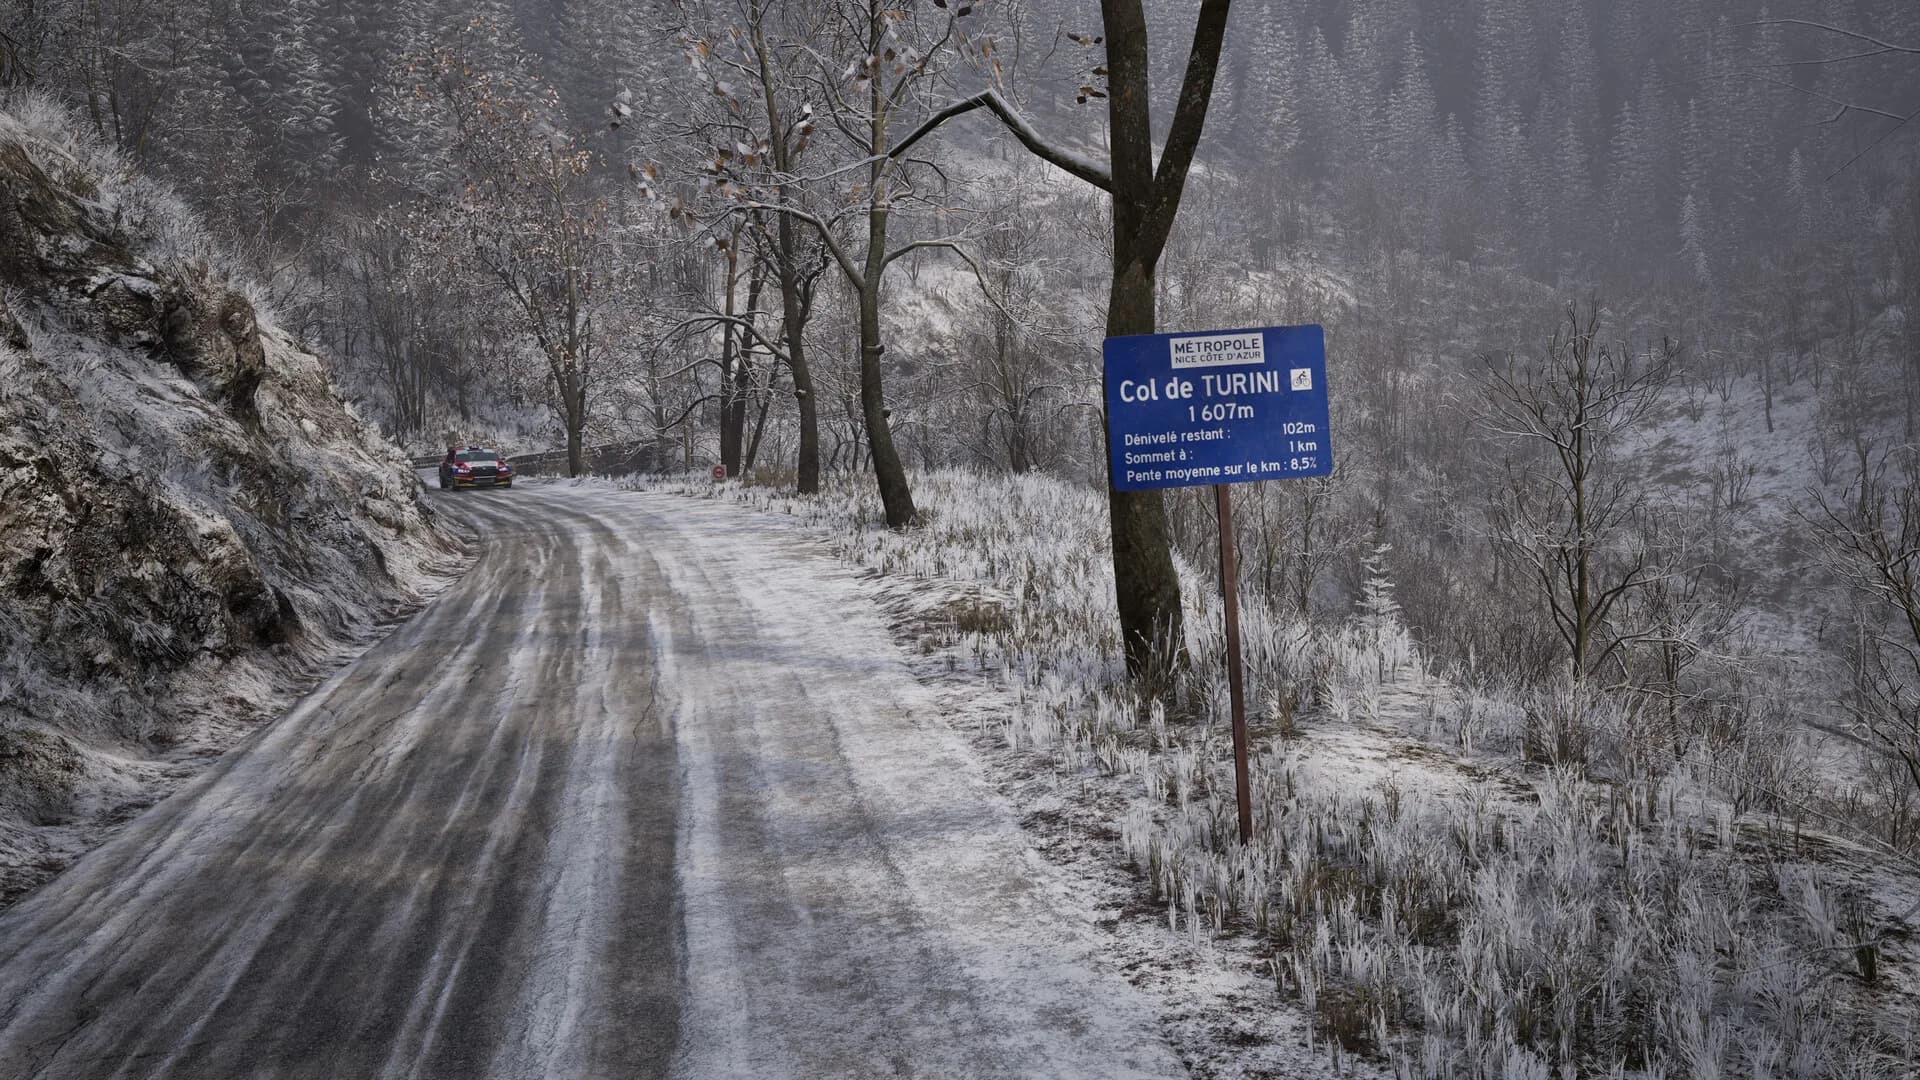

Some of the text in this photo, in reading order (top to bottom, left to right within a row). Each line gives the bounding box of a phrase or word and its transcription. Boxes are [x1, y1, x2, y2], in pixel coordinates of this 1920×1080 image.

[1174, 338, 1260, 354] MÉTROPOLE
[1175, 351, 1261, 364] NICE CÔTE D'AZUR
[1120, 370, 1279, 403] Col de TURINI
[1125, 431, 1177, 446] Dénivelé
[1181, 428, 1224, 442] restant
[1282, 422, 1316, 435] 102m
[1125, 450, 1176, 464] Sommet
[1179, 448, 1187, 461] à
[1289, 441, 1294, 452] 1
[1297, 439, 1317, 452] km
[1127, 469, 1161, 482] Pente
[1165, 465, 1220, 483] moyenne
[1224, 463, 1242, 475] sur
[1246, 461, 1258, 473] le
[1261, 459, 1280, 472] km
[1291, 456, 1317, 470] 8,5%
